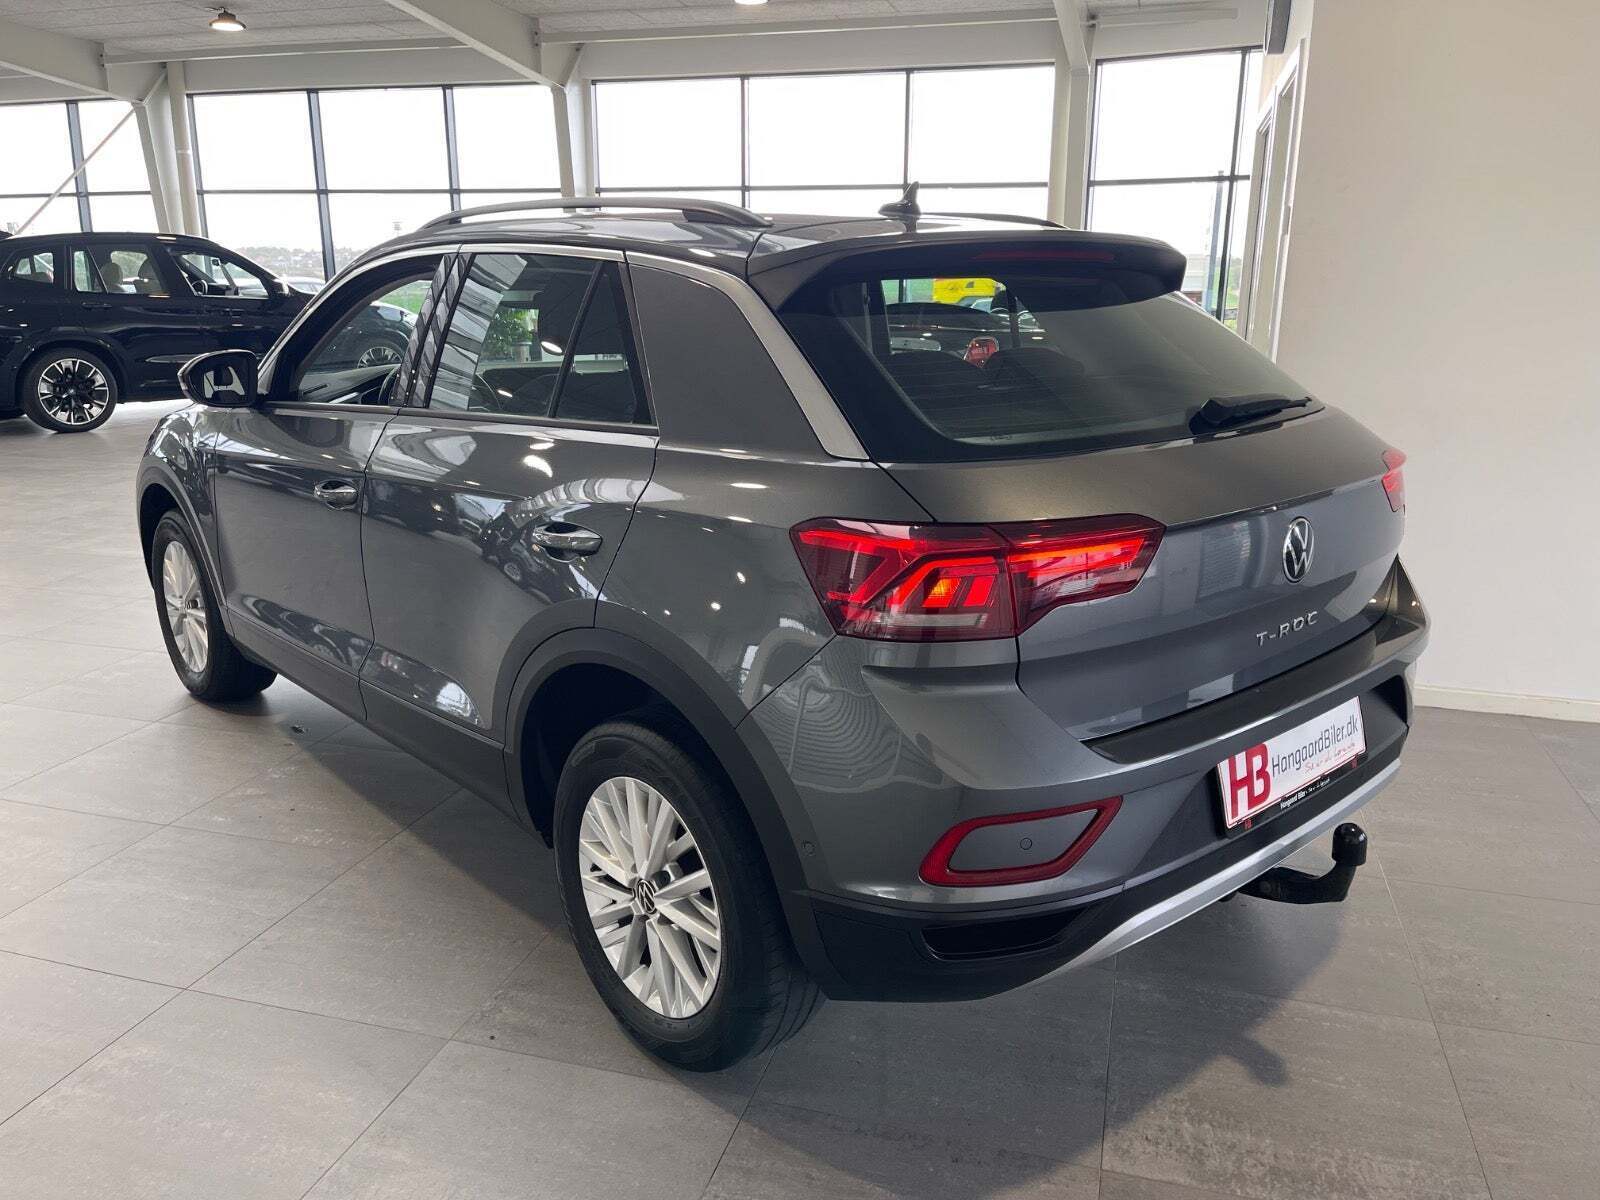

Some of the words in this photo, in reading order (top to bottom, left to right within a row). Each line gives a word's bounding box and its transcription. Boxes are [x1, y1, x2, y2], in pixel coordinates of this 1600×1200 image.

[1256, 611, 1318, 647] T-ROC
[1271, 714, 1359, 777] HangaardBiler.dk
[1227, 743, 1271, 819] HB
